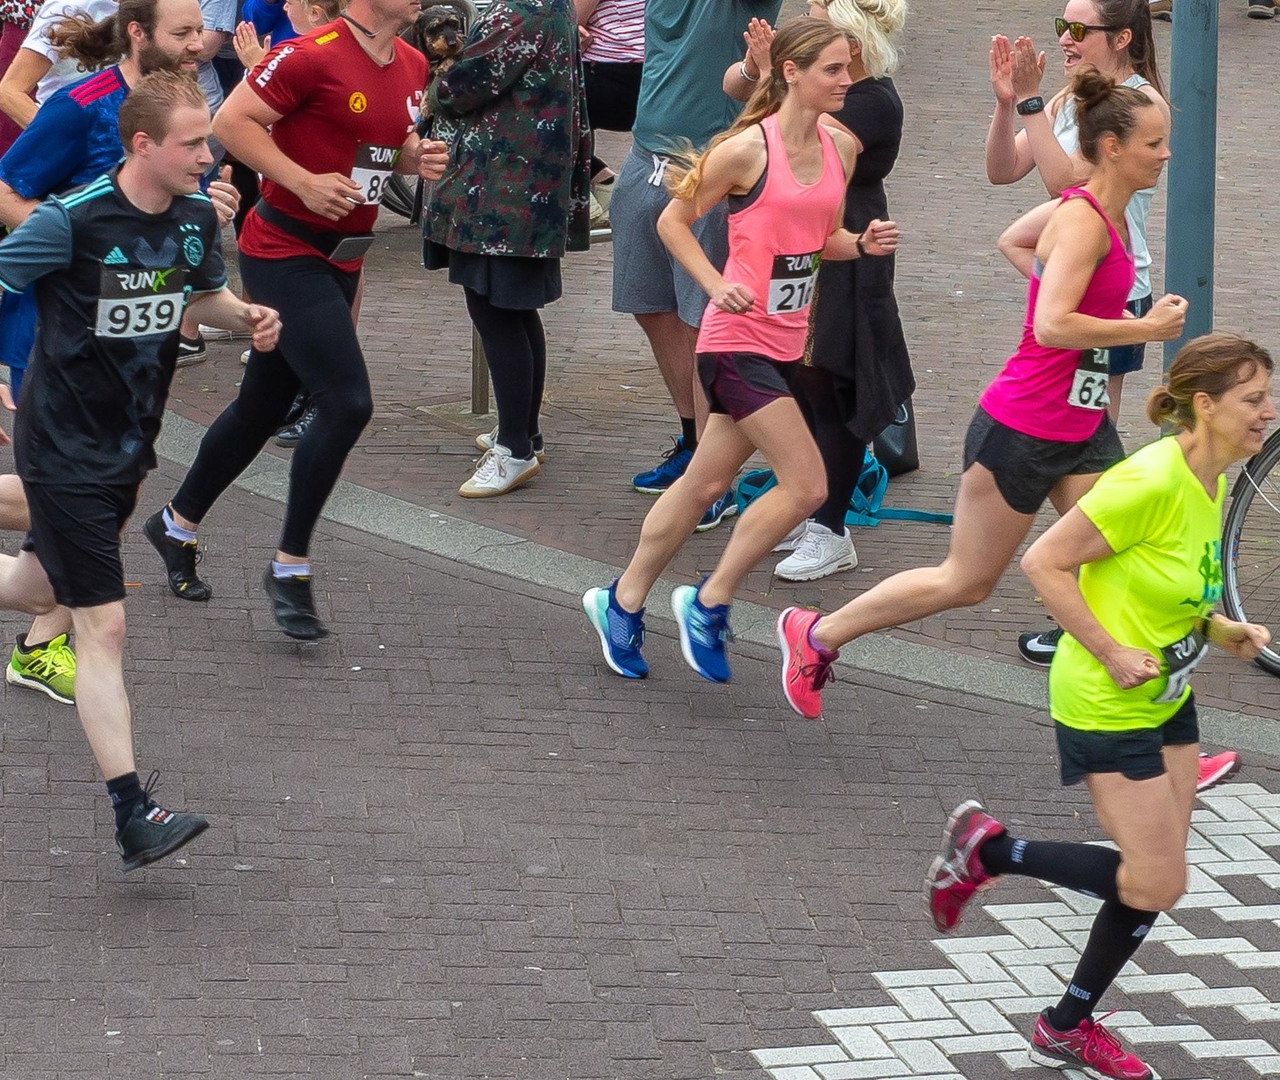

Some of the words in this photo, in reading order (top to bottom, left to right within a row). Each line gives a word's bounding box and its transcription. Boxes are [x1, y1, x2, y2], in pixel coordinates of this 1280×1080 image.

[369, 146, 401, 168] RUNX
[116, 267, 177, 293] RUNX
[108, 299, 176, 335] 939
